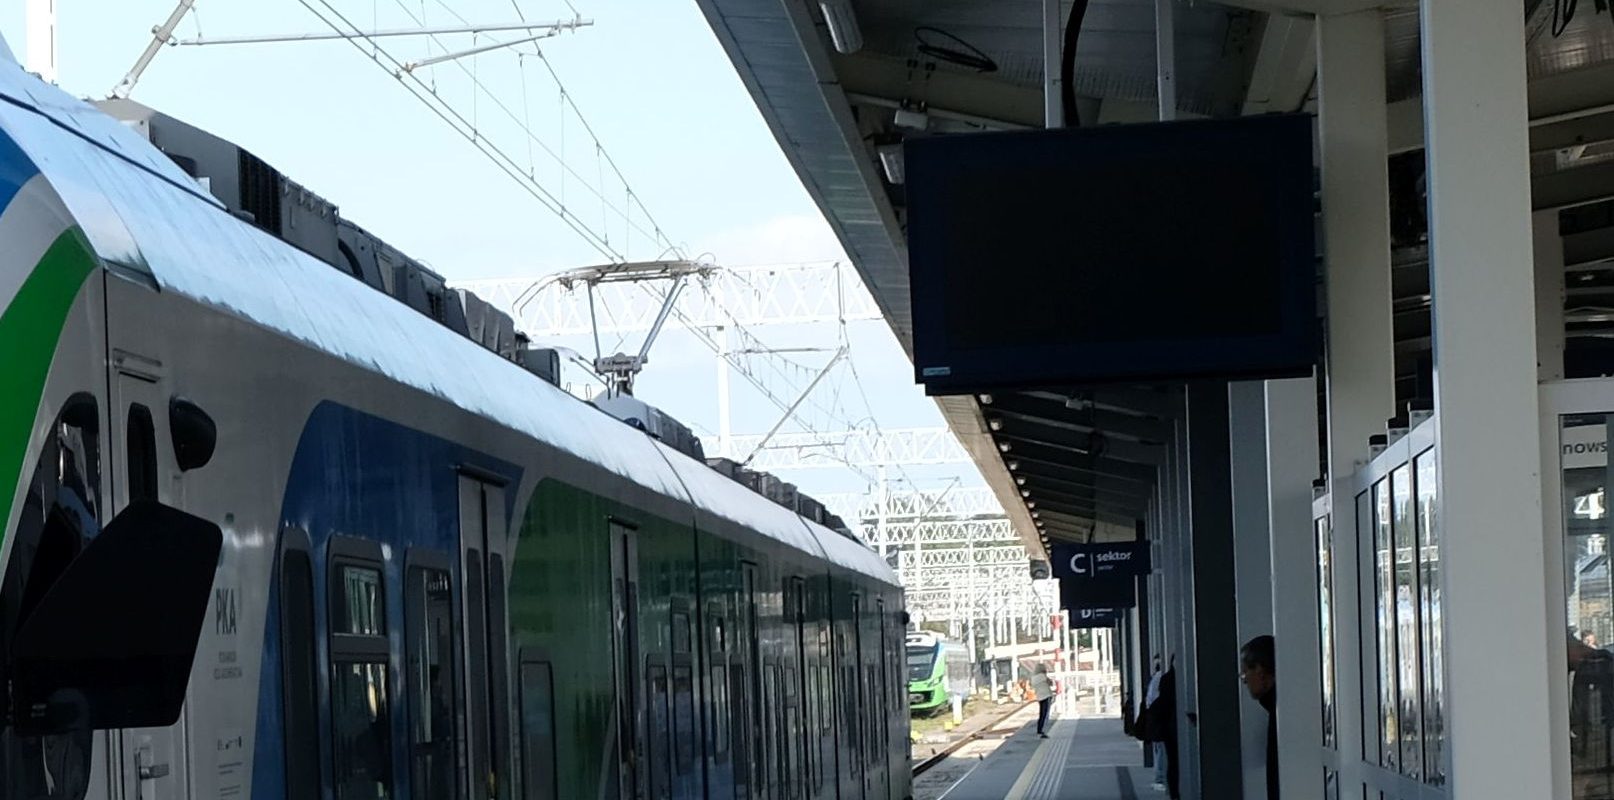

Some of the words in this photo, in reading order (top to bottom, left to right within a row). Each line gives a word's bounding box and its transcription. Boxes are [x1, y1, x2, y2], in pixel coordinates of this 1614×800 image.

[1070, 553, 1086, 573] C
[1096, 551, 1132, 562] sektor
[216, 588, 237, 635] PKA
